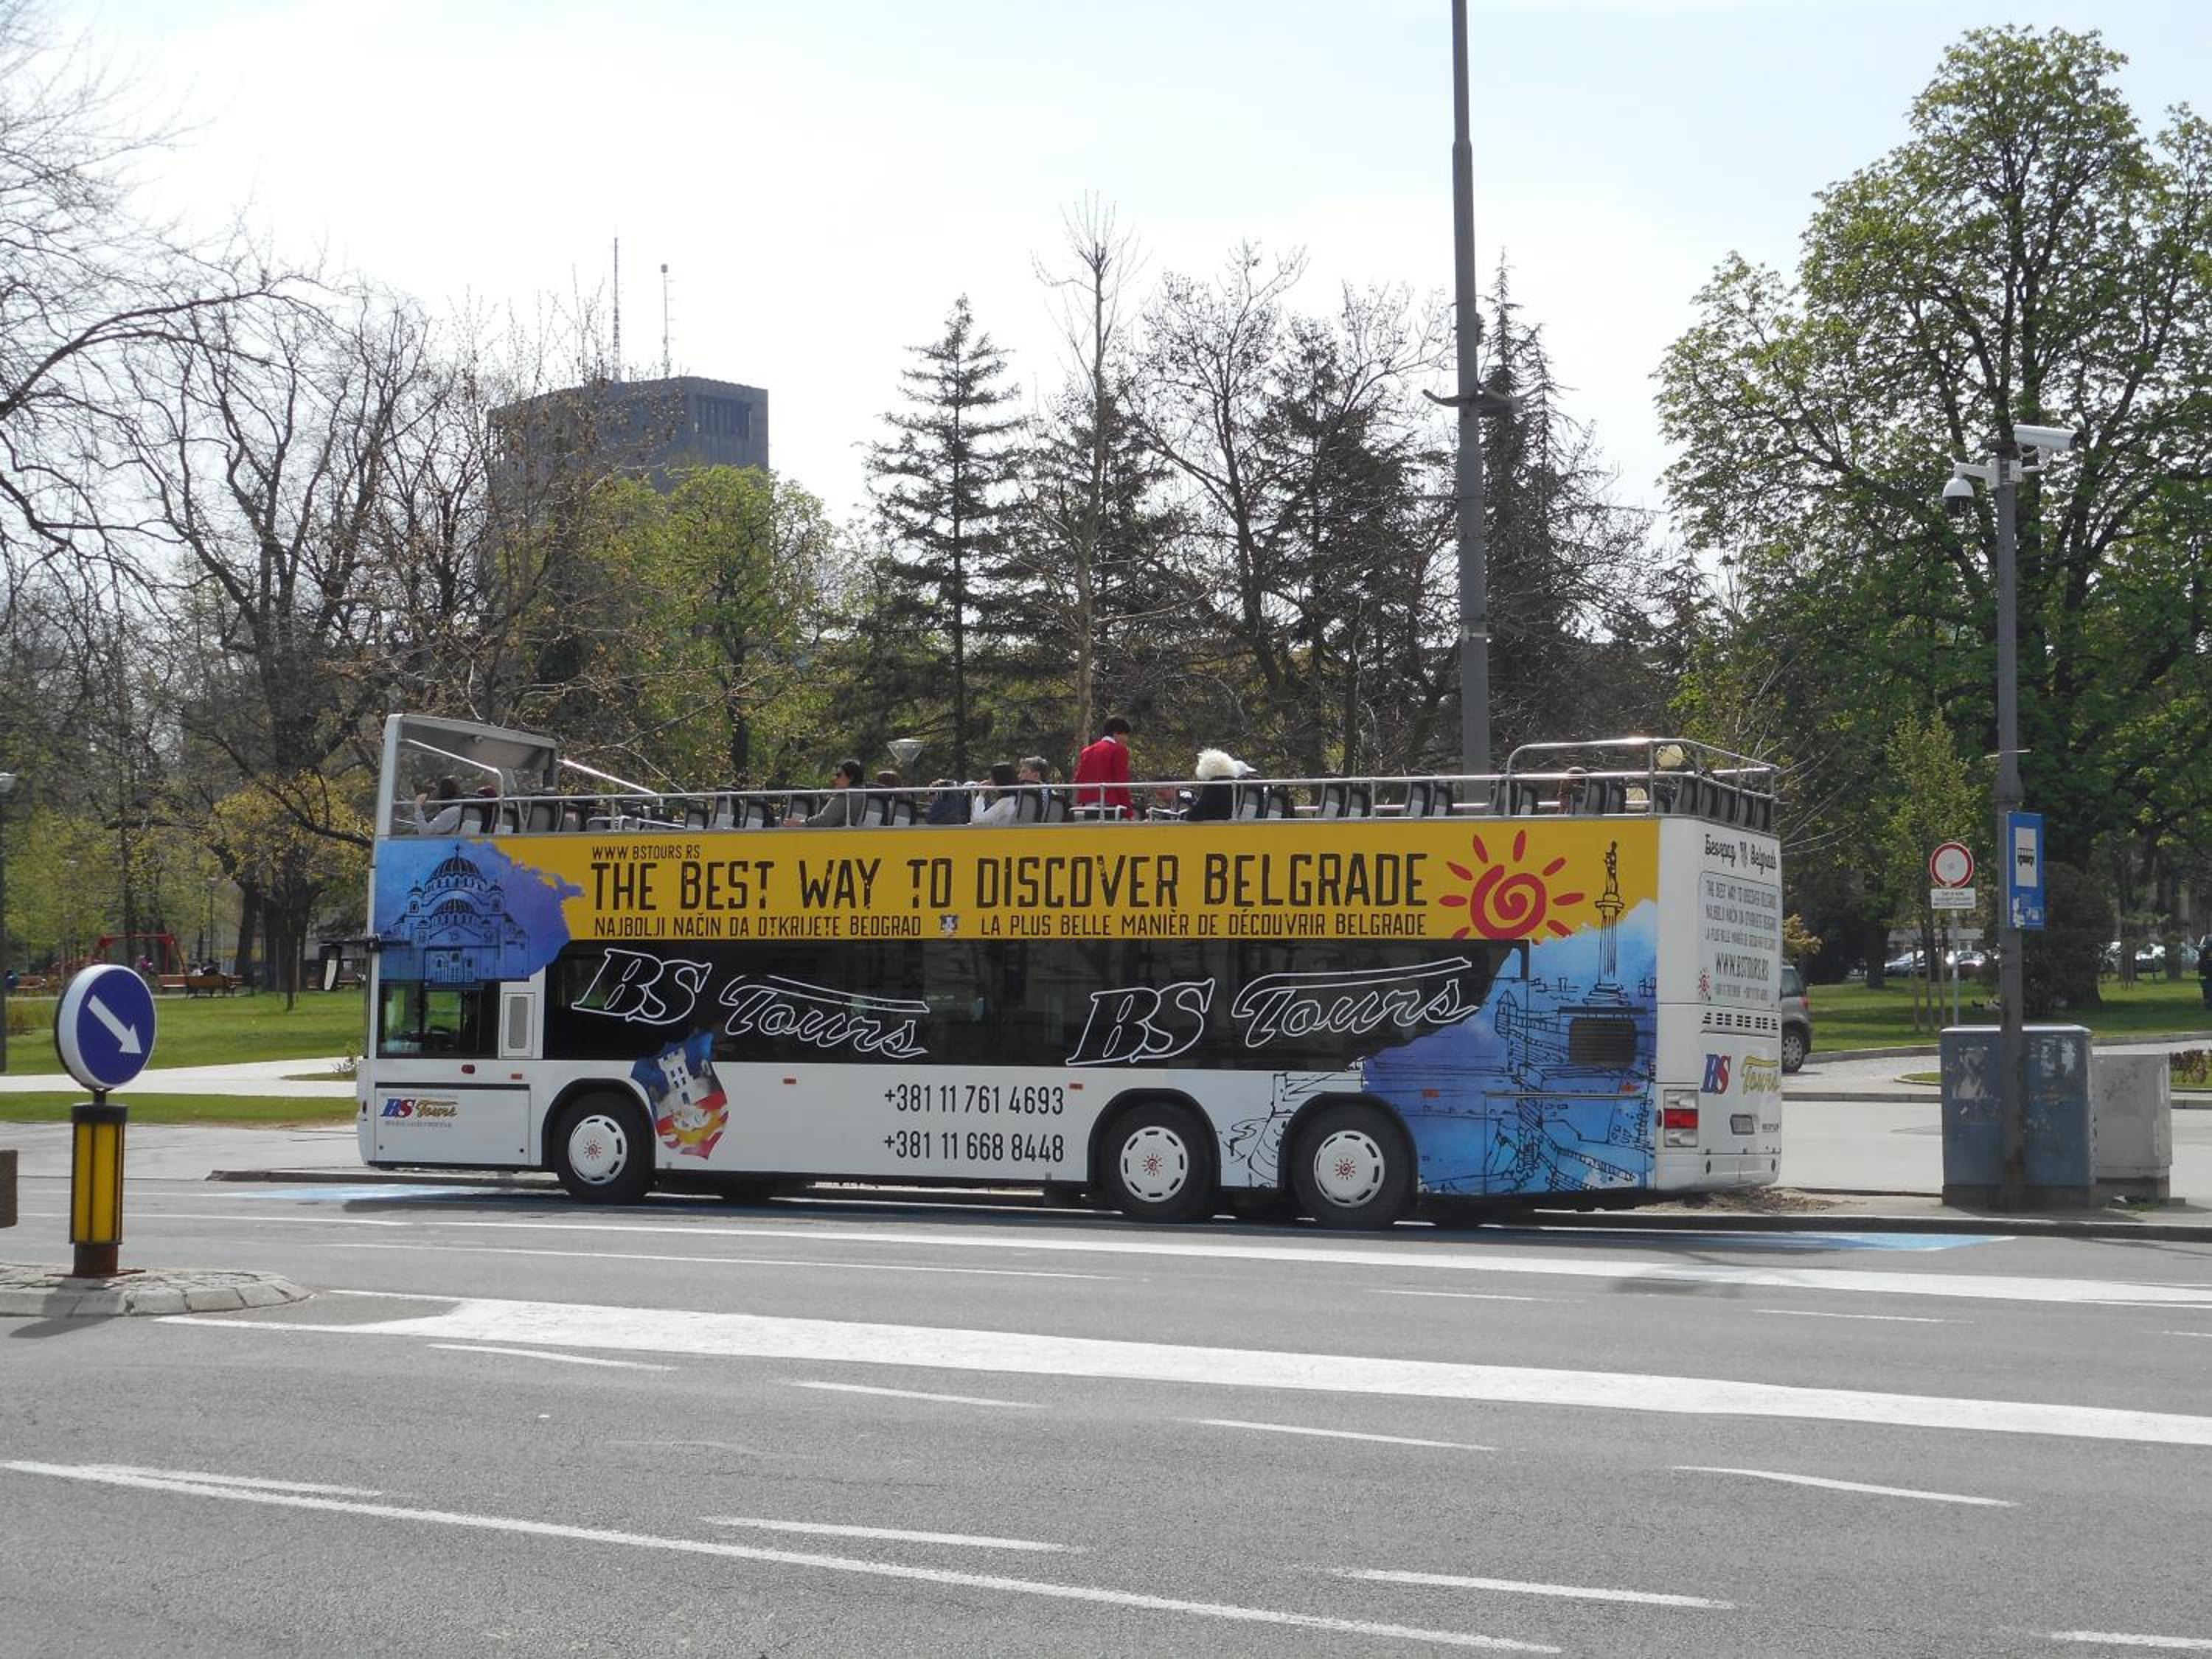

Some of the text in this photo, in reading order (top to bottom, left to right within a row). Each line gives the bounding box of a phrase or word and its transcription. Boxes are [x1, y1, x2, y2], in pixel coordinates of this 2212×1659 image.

[591, 853, 1428, 911] THE BEST WAY TO DISCOVER BELGRADE
[594, 912, 922, 937] NAJBOLJI NAČIN DA OTKRIJETE BEOGRAD
[981, 908, 1427, 936] LA PLUS BELLE MANIÈR DE DÉCOUVRIR BELGRADE
[571, 947, 931, 1059] BS Tours
[1065, 956, 1479, 1066] BS Tours
[1700, 1053, 1732, 1095] BS
[379, 1098, 416, 1119] BS
[884, 1083, 1065, 1116] +381 11 761 4693
[884, 1130, 1065, 1163] +381 11 668 8448
